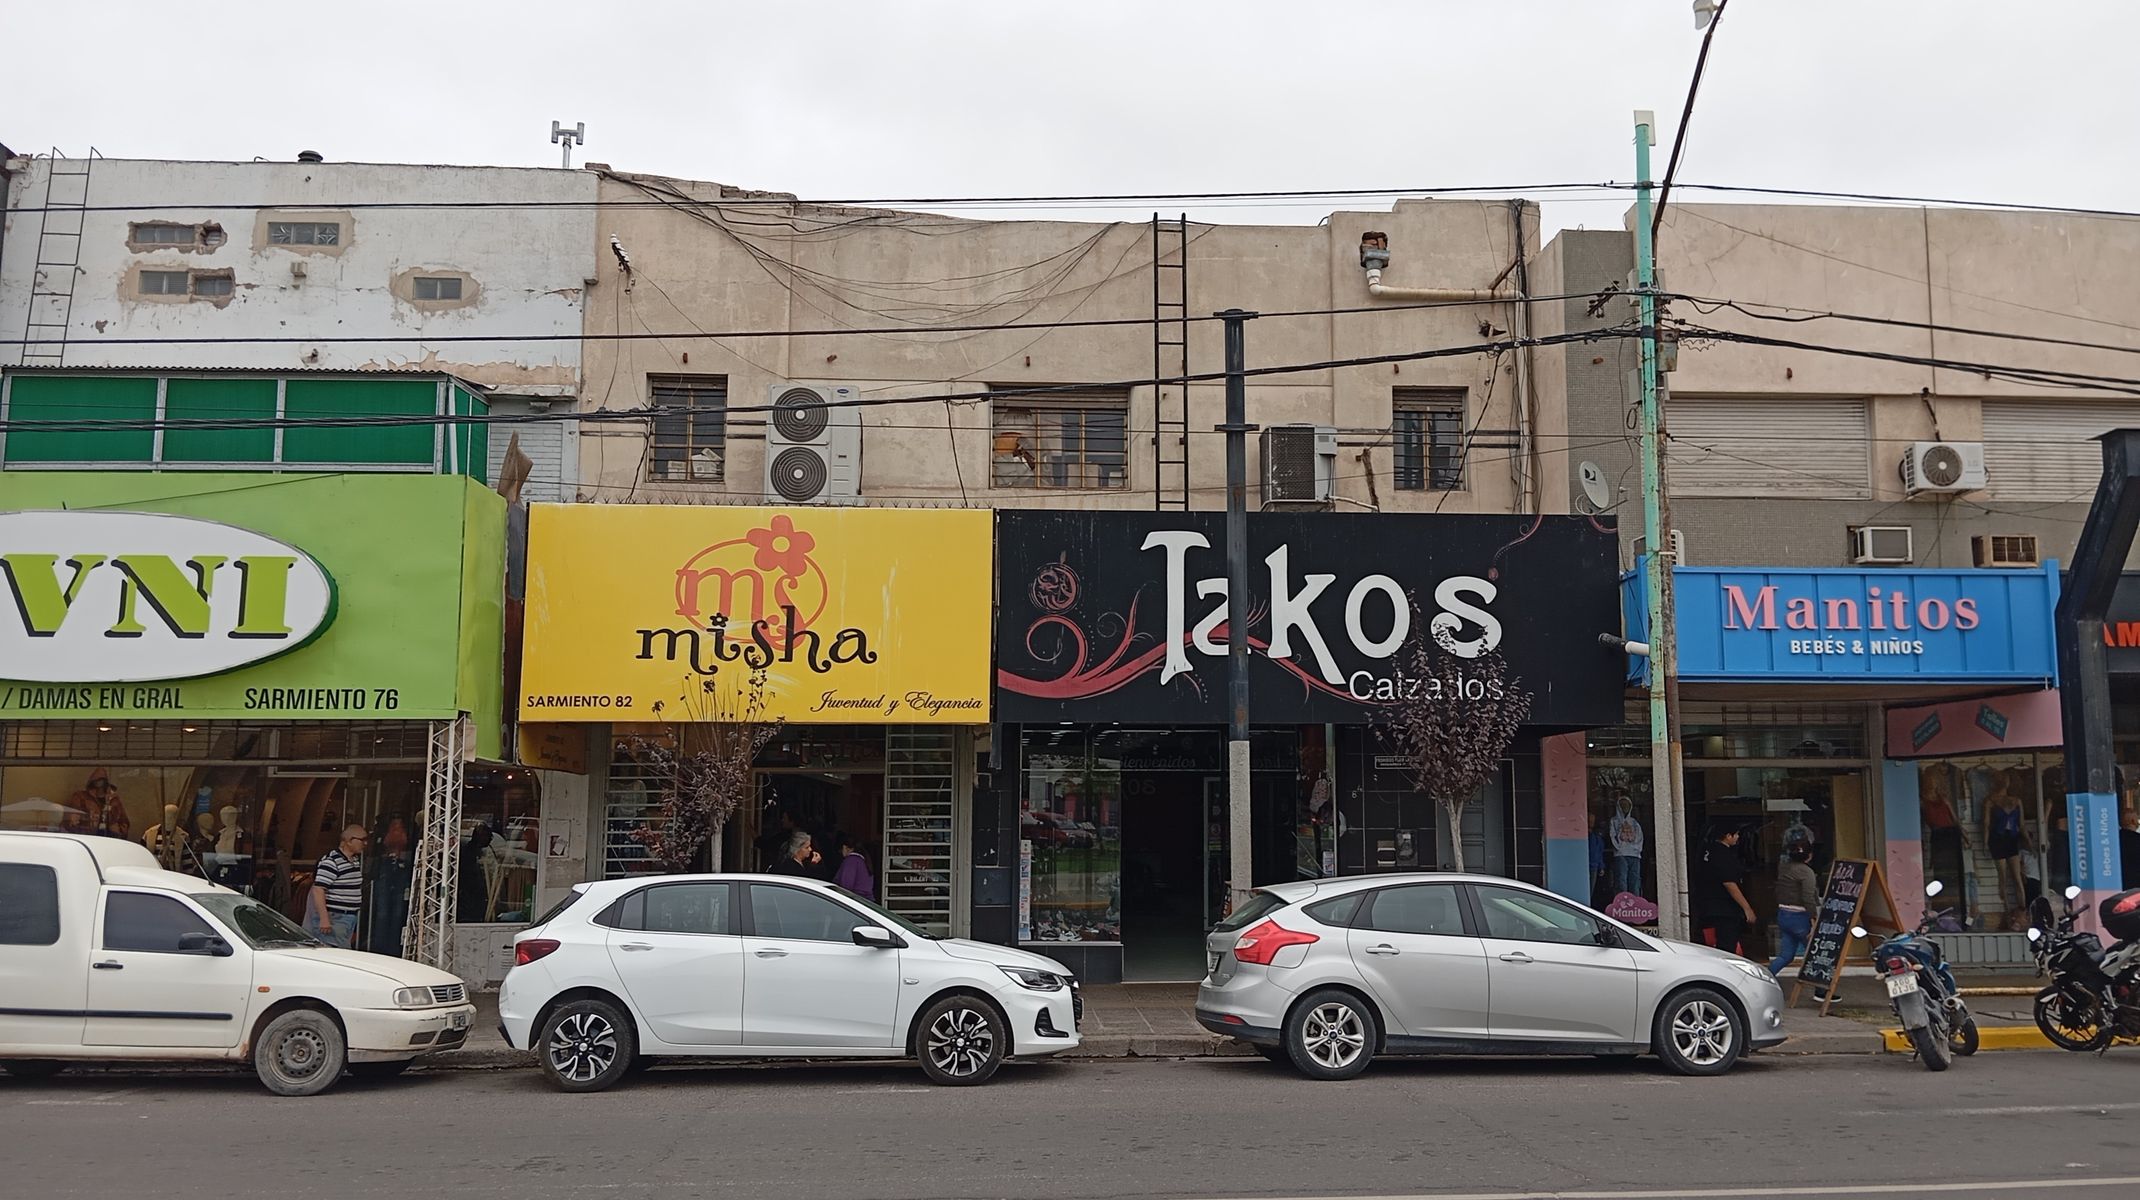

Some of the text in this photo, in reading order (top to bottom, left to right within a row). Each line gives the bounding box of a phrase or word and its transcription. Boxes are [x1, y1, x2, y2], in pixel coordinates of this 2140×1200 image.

[0, 554, 298, 639] VNI
[1140, 531, 1502, 685] Takos
[1722, 585, 1980, 631] Manitos
[635, 605, 878, 675] misha
[1790, 634, 1924, 655] BEBÉS & NIÑOS
[19, 687, 92, 710] DAMAS
[100, 687, 125, 710] EN
[132, 687, 184, 710] GRAL
[244, 687, 399, 710] SARMIENTO 76
[527, 695, 633, 708] SARMIENTO 82
[810, 689, 983, 717] Juventud y Elegancia
[1612, 906, 1653, 918] Manitos
